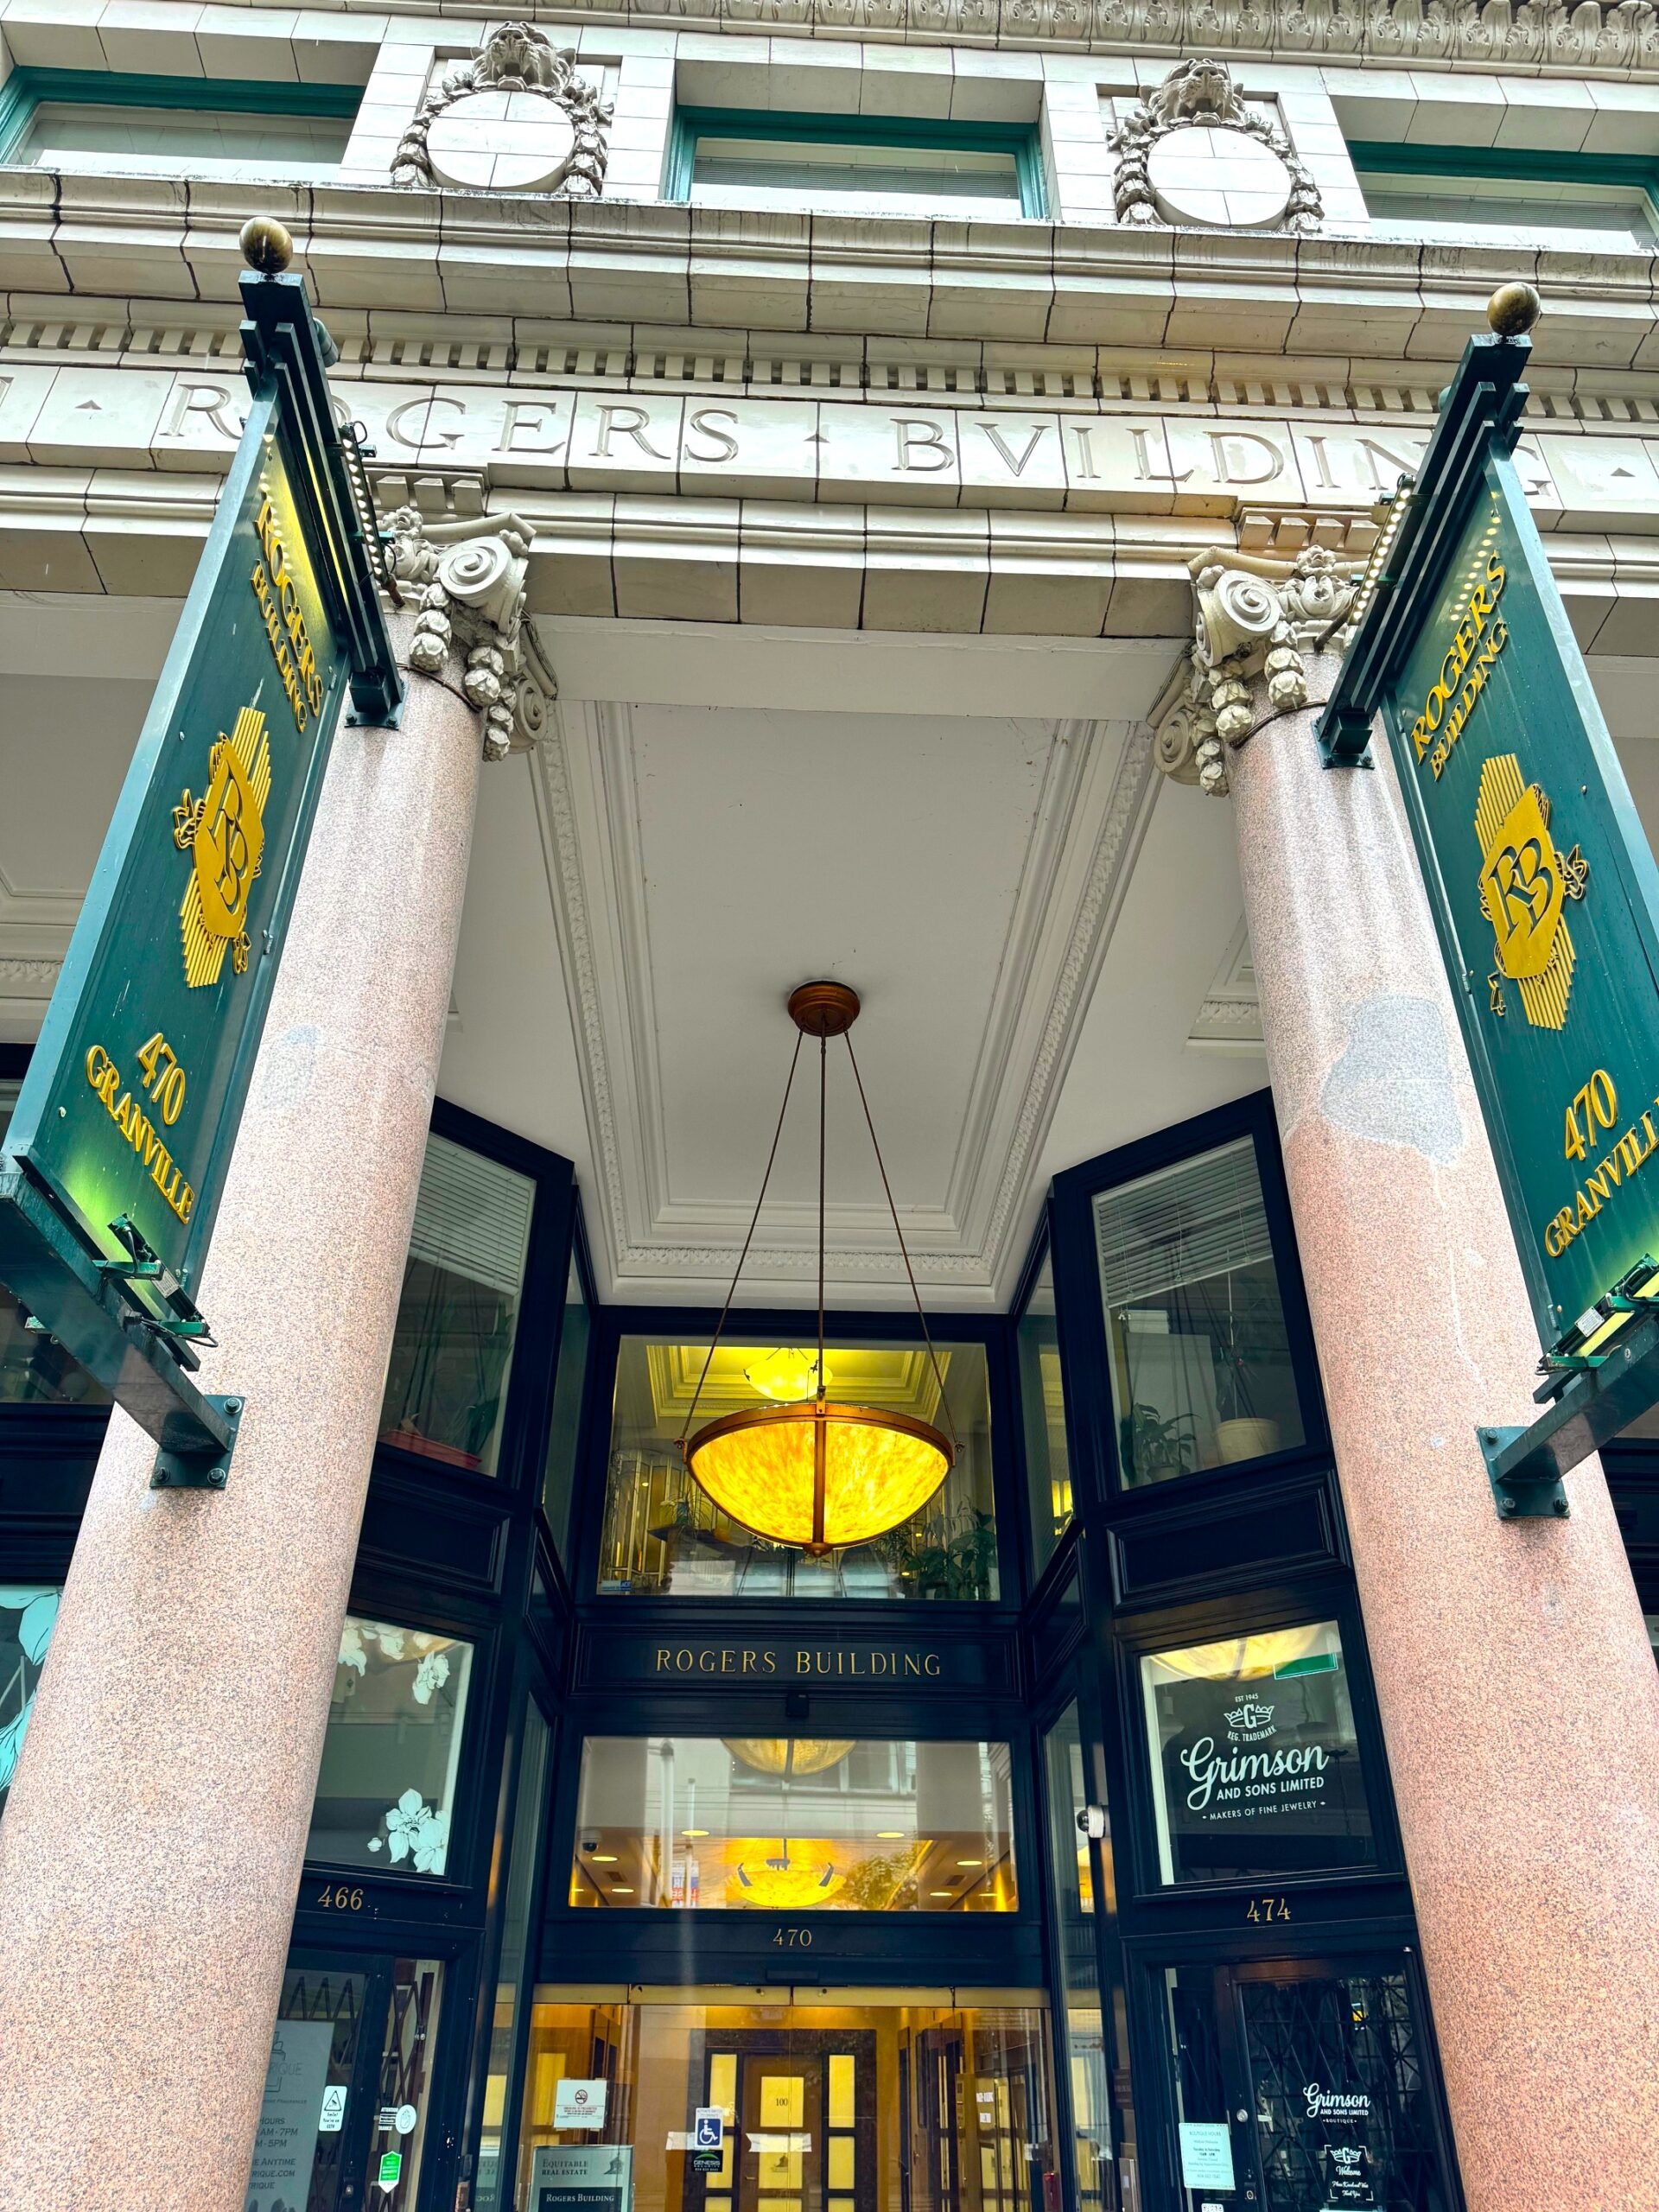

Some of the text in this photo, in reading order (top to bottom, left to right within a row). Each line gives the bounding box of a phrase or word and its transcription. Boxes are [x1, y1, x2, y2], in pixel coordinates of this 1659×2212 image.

[159, 381, 1551, 498] RGERS BVILDIN
[253, 492, 324, 718] ROGERS
[250, 558, 308, 734] BUILDING
[1411, 549, 1507, 766] ROGERS
[1430, 617, 1508, 783] BUILDING
[138, 1032, 187, 1126] 470
[1565, 1068, 1618, 1161] 470
[86, 1045, 195, 1225] GRANVILLE
[1544, 1096, 1659, 1257] GRANVILL
[655, 1649, 942, 1676] ROGERS BUILDING
[1245, 1693, 1259, 1701] 1945
[1227, 1725, 1277, 1742] REG. TRADEMARK
[1180, 1737, 1330, 1811] Grimson
[1217, 1776, 1325, 1801] AND SONS LIMITED
[1210, 1800, 1318, 1821] MAKERS OF FINE JEWELRY
[317, 1885, 365, 1911] 466
[1247, 1897, 1292, 1923] 474
[772, 1928, 812, 1948] 470
[776, 2098, 789, 2107] 100
[1303, 2082, 1371, 2118] Grimson
[279, 2127, 299, 2137] 7PM
[543, 2158, 588, 2168] EQUITABLE
[546, 2193, 615, 2202] ROGERS BUILDING
